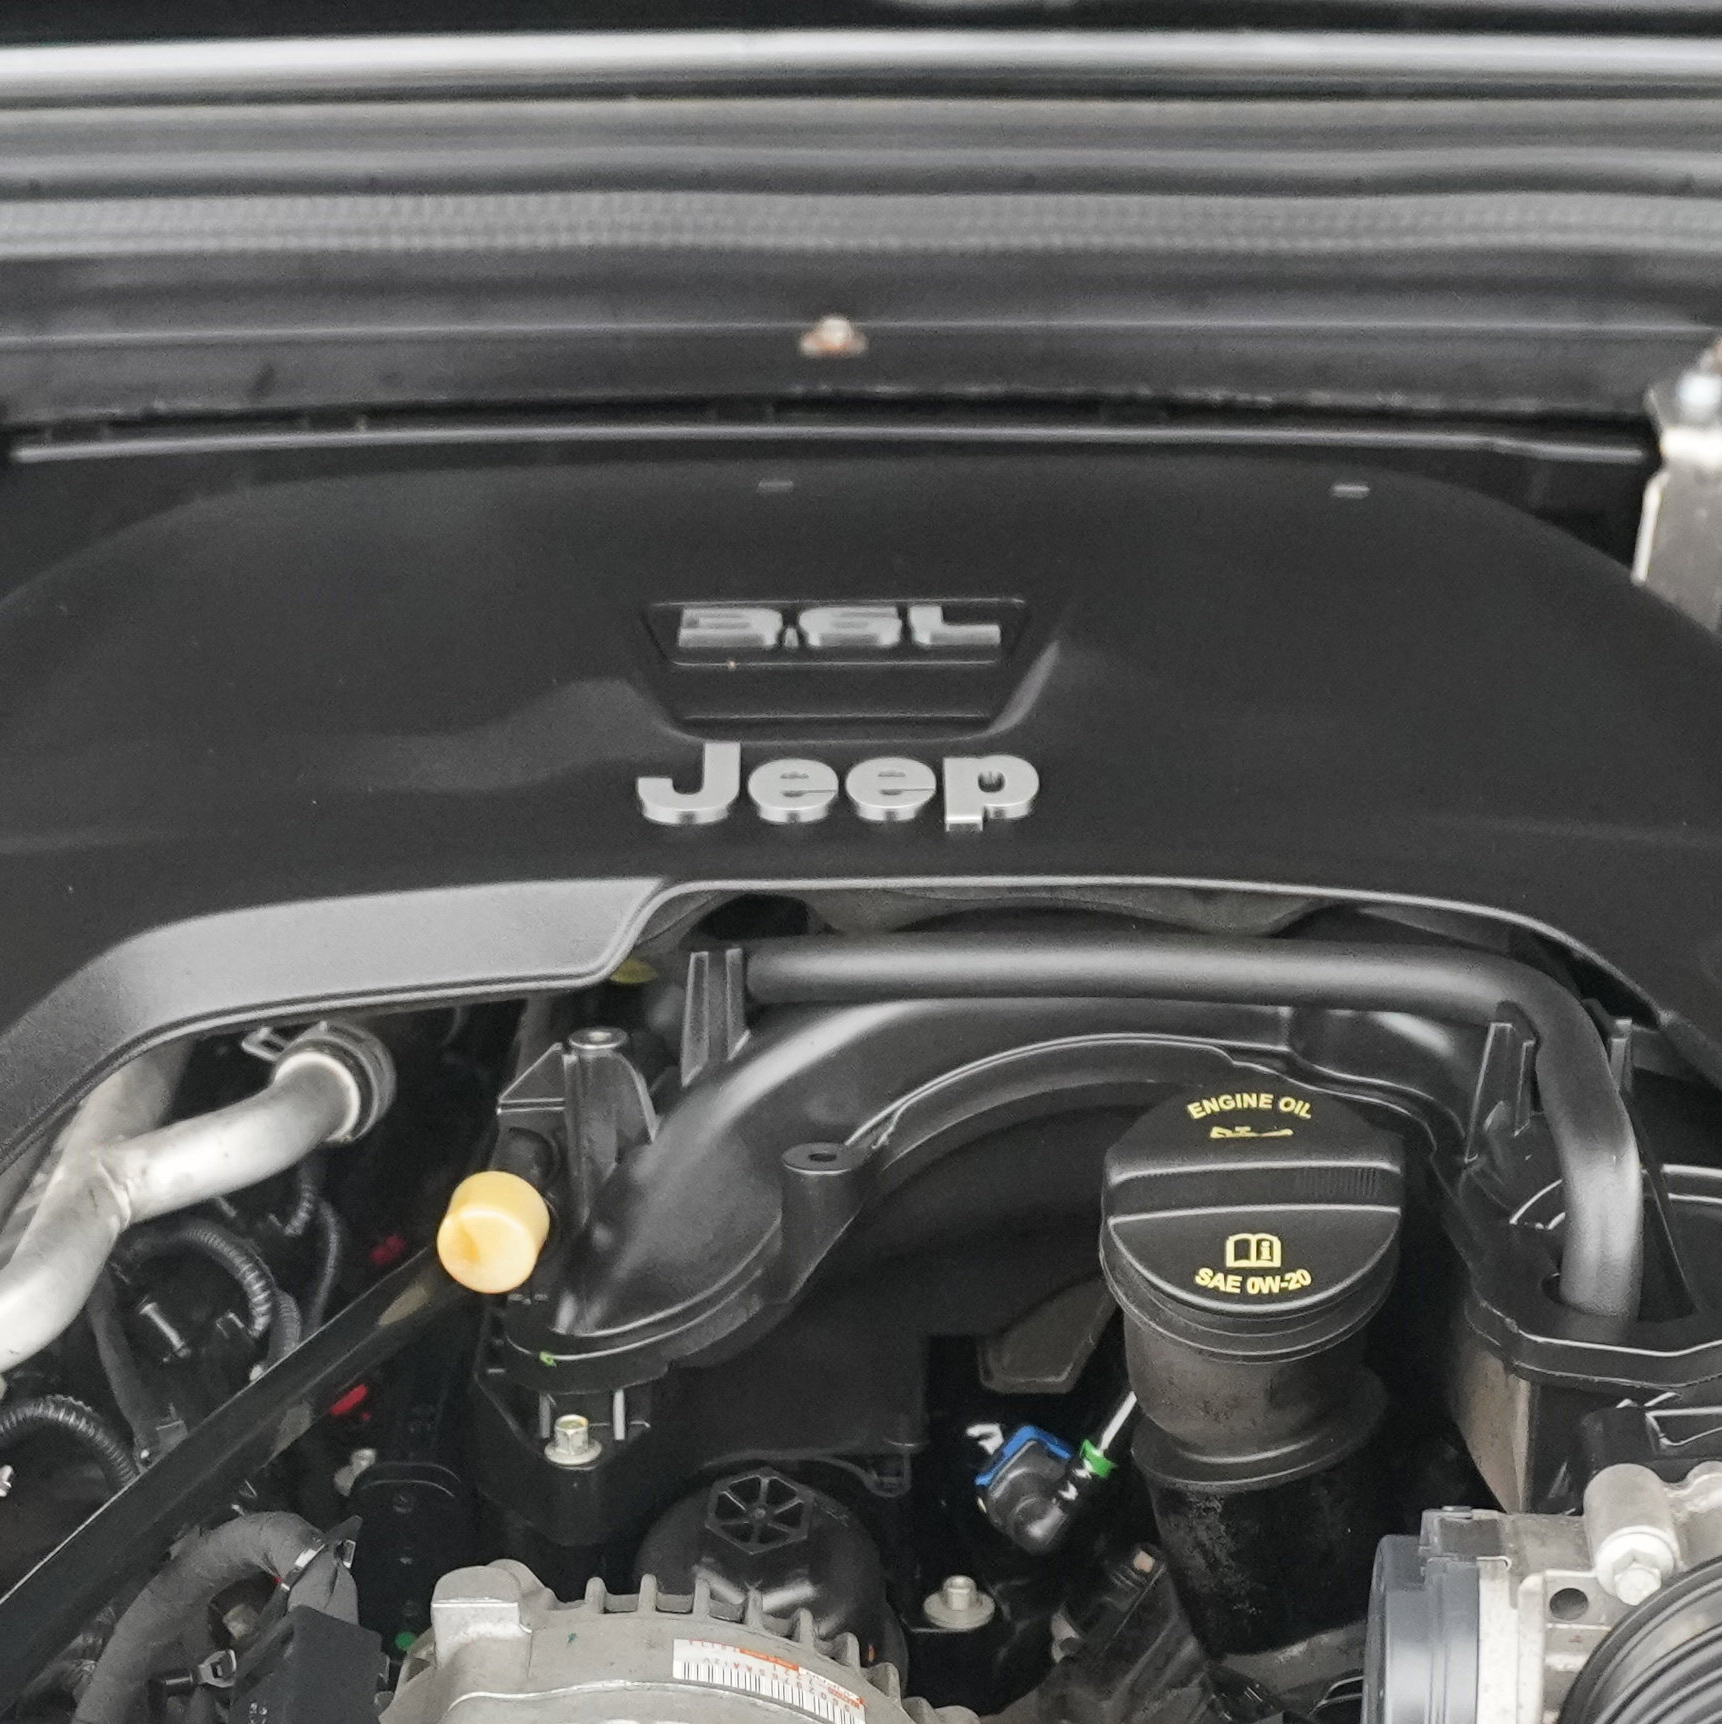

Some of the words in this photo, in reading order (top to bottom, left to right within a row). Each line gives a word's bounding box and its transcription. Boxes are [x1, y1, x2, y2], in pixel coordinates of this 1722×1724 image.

[678, 605, 1002, 649] 3.6L
[636, 741, 1041, 832] Jeep
[1187, 1092, 1274, 1120] ENGINE
[1278, 1096, 1313, 1119] OIL
[1194, 1266, 1243, 1294] SAE
[1246, 1267, 1312, 1295] 0W-20
